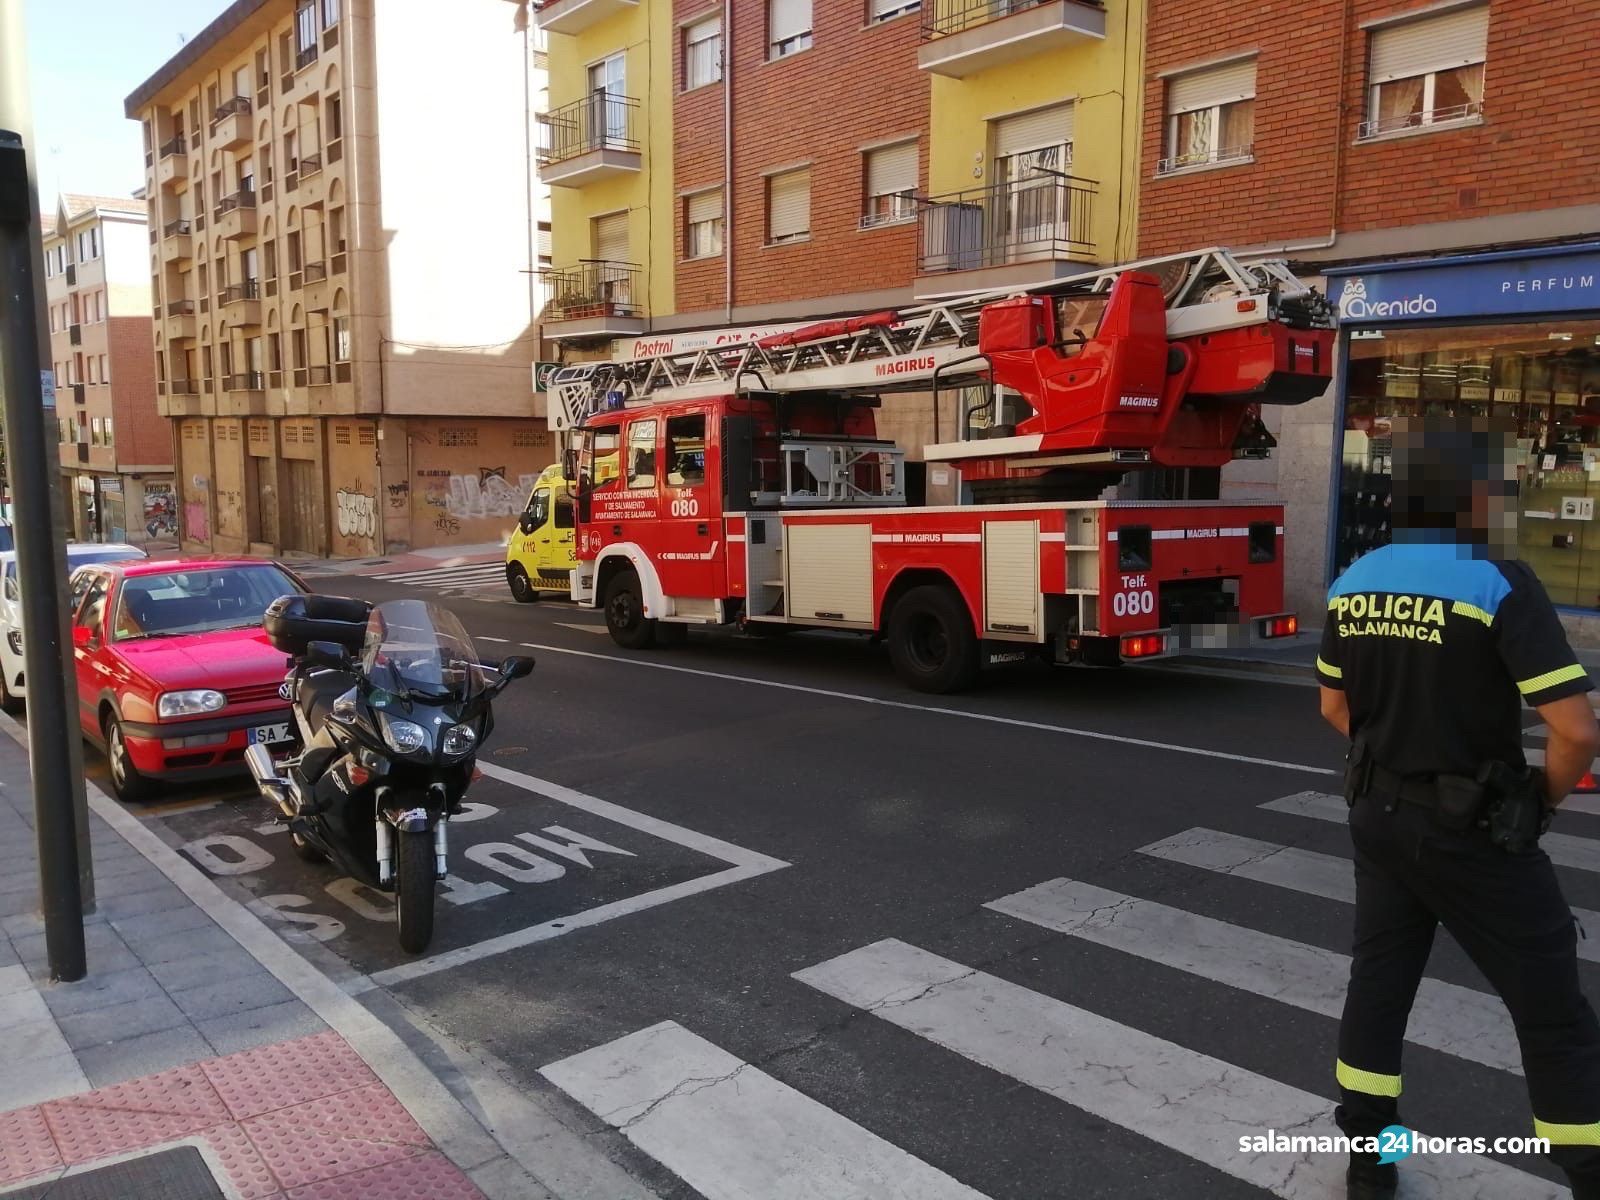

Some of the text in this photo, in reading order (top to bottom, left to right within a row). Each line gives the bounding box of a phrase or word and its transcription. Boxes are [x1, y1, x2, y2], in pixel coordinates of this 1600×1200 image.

[633, 338, 674, 359] Castrol
[875, 356, 935, 377] MAGIRUS
[1119, 396, 1159, 408] MAGIRUS
[613, 491, 632, 500] CONTRA
[671, 499, 699, 517] 080
[904, 533, 941, 542] MAGIRUS
[1186, 528, 1219, 538] MAGIRUS
[526, 541, 536, 553] 112
[676, 552, 700, 560] MAGIRUS
[1121, 574, 1148, 589] Telf.
[1113, 590, 1154, 617] 080
[1337, 594, 1446, 626] POLICIA
[257, 728, 276, 743] SA
